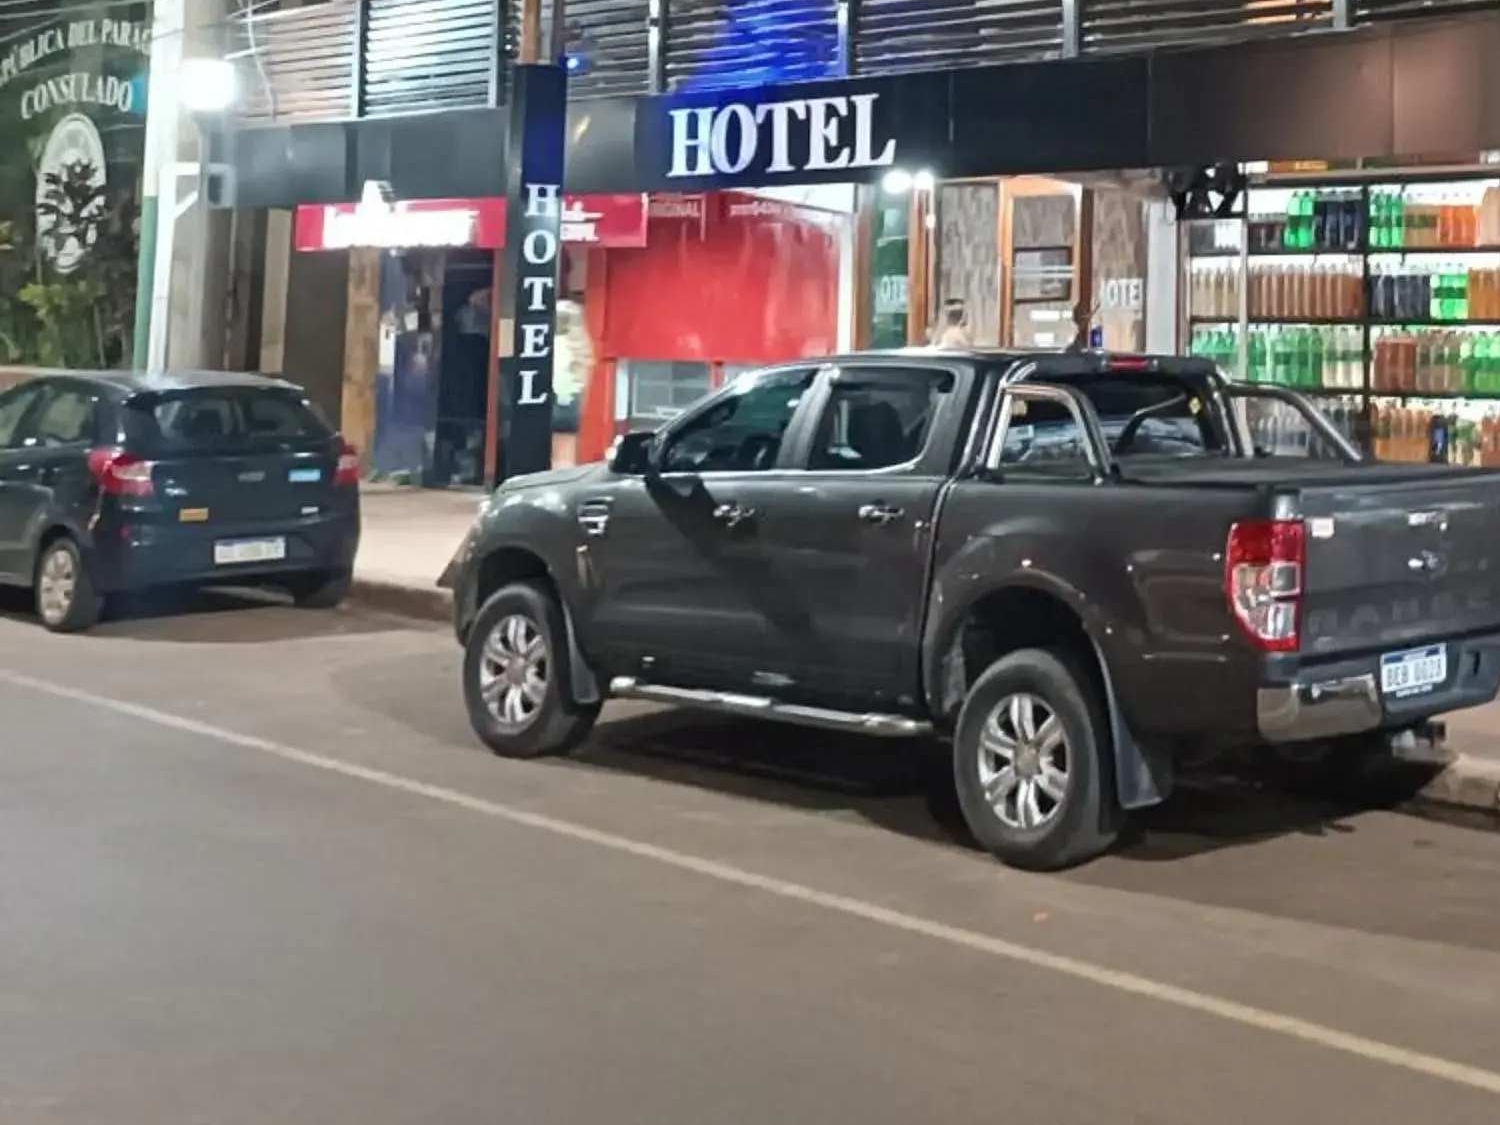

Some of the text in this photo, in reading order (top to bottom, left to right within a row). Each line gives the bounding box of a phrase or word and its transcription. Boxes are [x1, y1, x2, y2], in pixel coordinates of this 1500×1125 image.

[67, 19, 98, 48] DEL
[20, 72, 134, 120] CONSULADO
[665, 93, 897, 178] HOTEL
[516, 183, 561, 406] HOTEL
